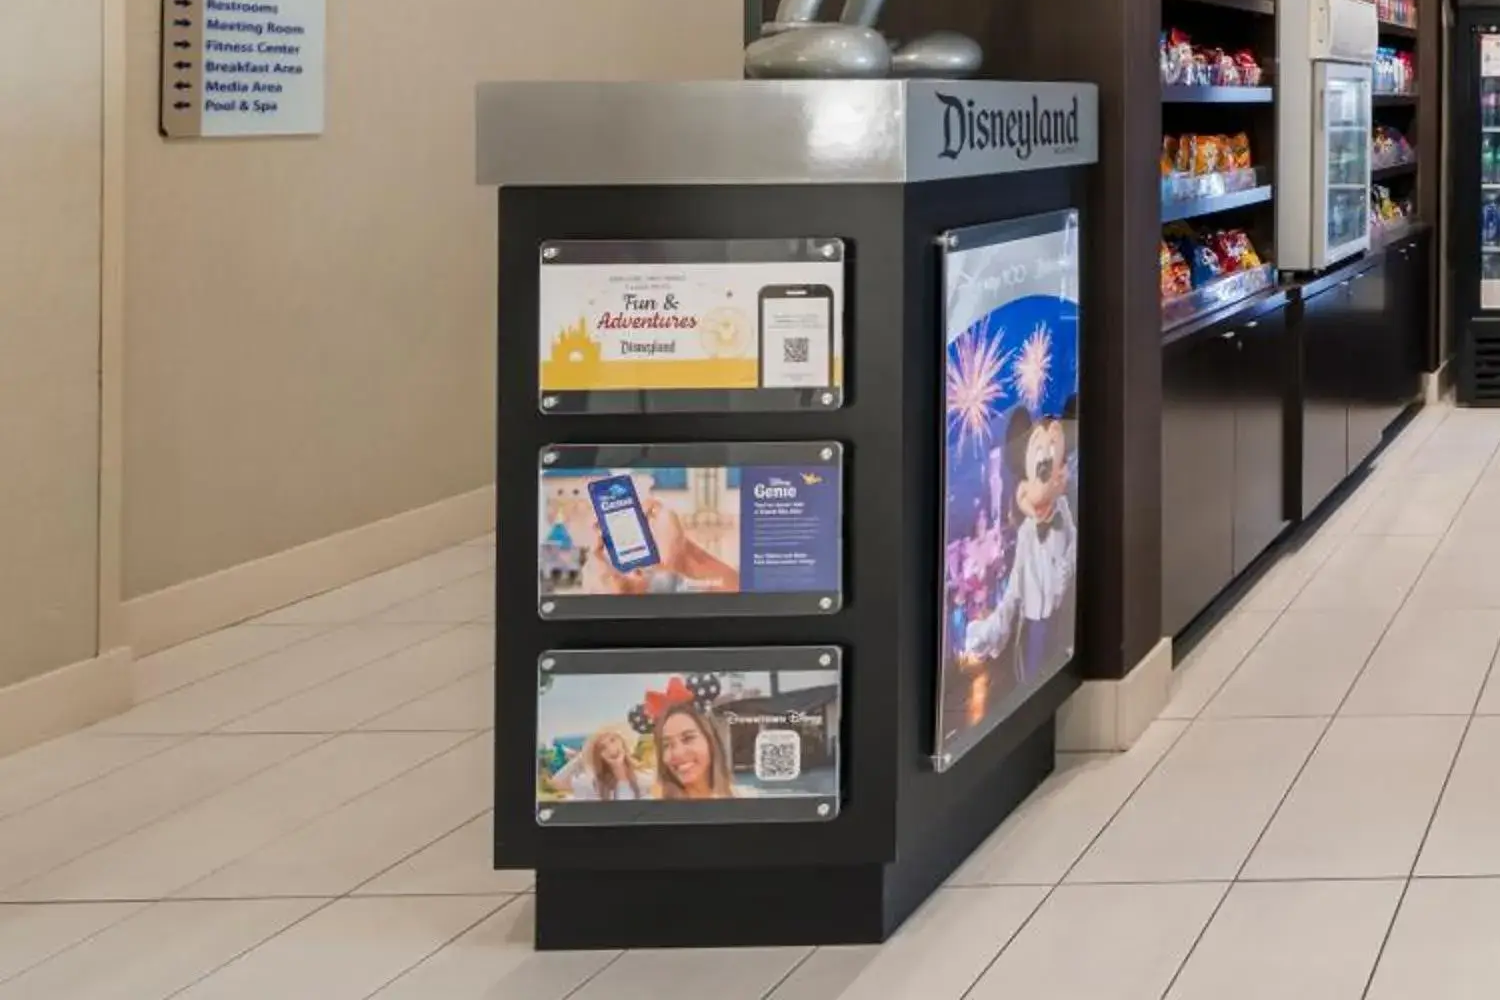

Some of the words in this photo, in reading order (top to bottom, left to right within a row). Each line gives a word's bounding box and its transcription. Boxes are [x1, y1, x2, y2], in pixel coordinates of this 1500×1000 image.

[206, 19, 263, 35] Meeting
[267, 21, 304, 34] Room
[206, 39, 253, 53] Fitness
[257, 41, 300, 55] Center
[205, 60, 269, 74] Breakfast
[273, 61, 303, 74] Area
[205, 81, 249, 93] Media
[252, 81, 283, 93] Area
[205, 99, 235, 111] Pool
[239, 100, 249, 111] &
[253, 99, 278, 113] Spa
[935, 90, 1079, 160] Disneyland
[623, 293, 657, 310] Fun
[663, 293, 680, 310] &
[597, 311, 697, 329] Adventures
[620, 340, 675, 355] Disneyland
[754, 483, 797, 498] Genie
